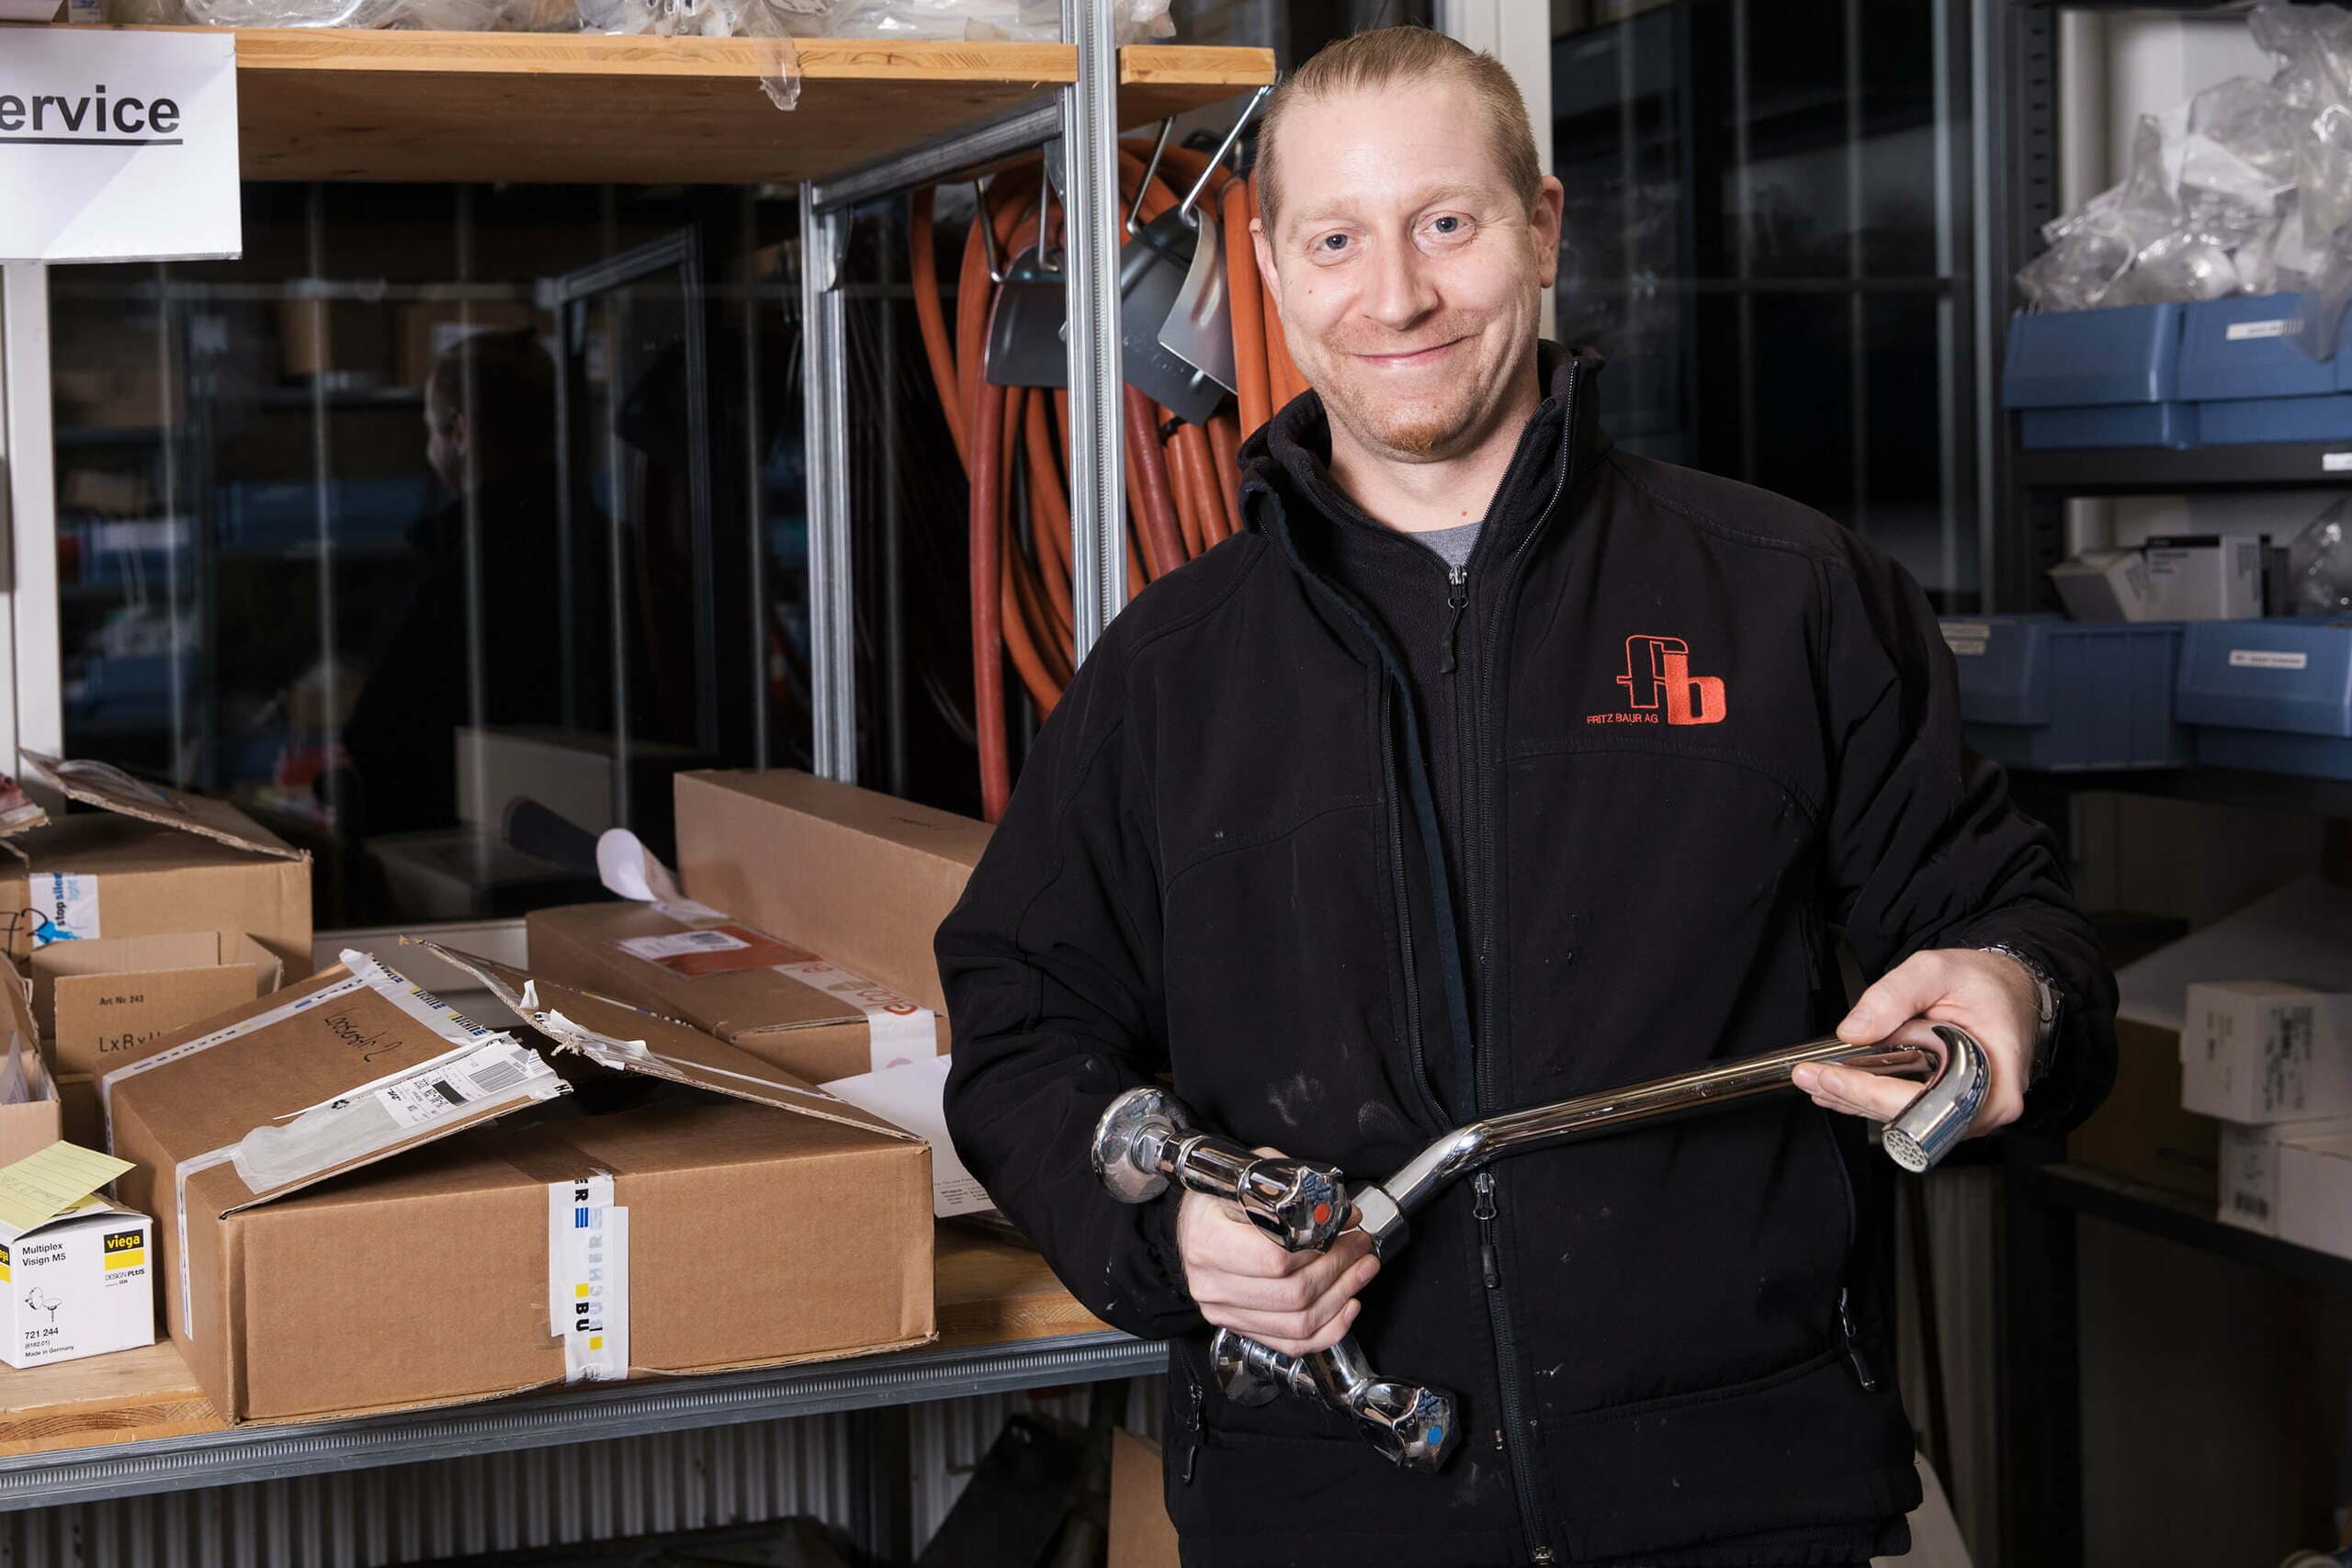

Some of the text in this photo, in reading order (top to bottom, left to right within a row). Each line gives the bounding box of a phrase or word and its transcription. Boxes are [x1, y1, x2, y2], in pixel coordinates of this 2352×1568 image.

[0, 85, 181, 133] ervice
[1587, 713, 1659, 725] FRITZ BAUR AG
[55, 901, 66, 927] stop
[107, 1234, 140, 1249] viega
[22, 1242, 63, 1256] Multiplex
[22, 1253, 66, 1267] Visign M5
[127, 1269, 145, 1278] PLUS
[25, 1327, 59, 1339] 721 244
[50, 1345, 74, 1355] Germany
